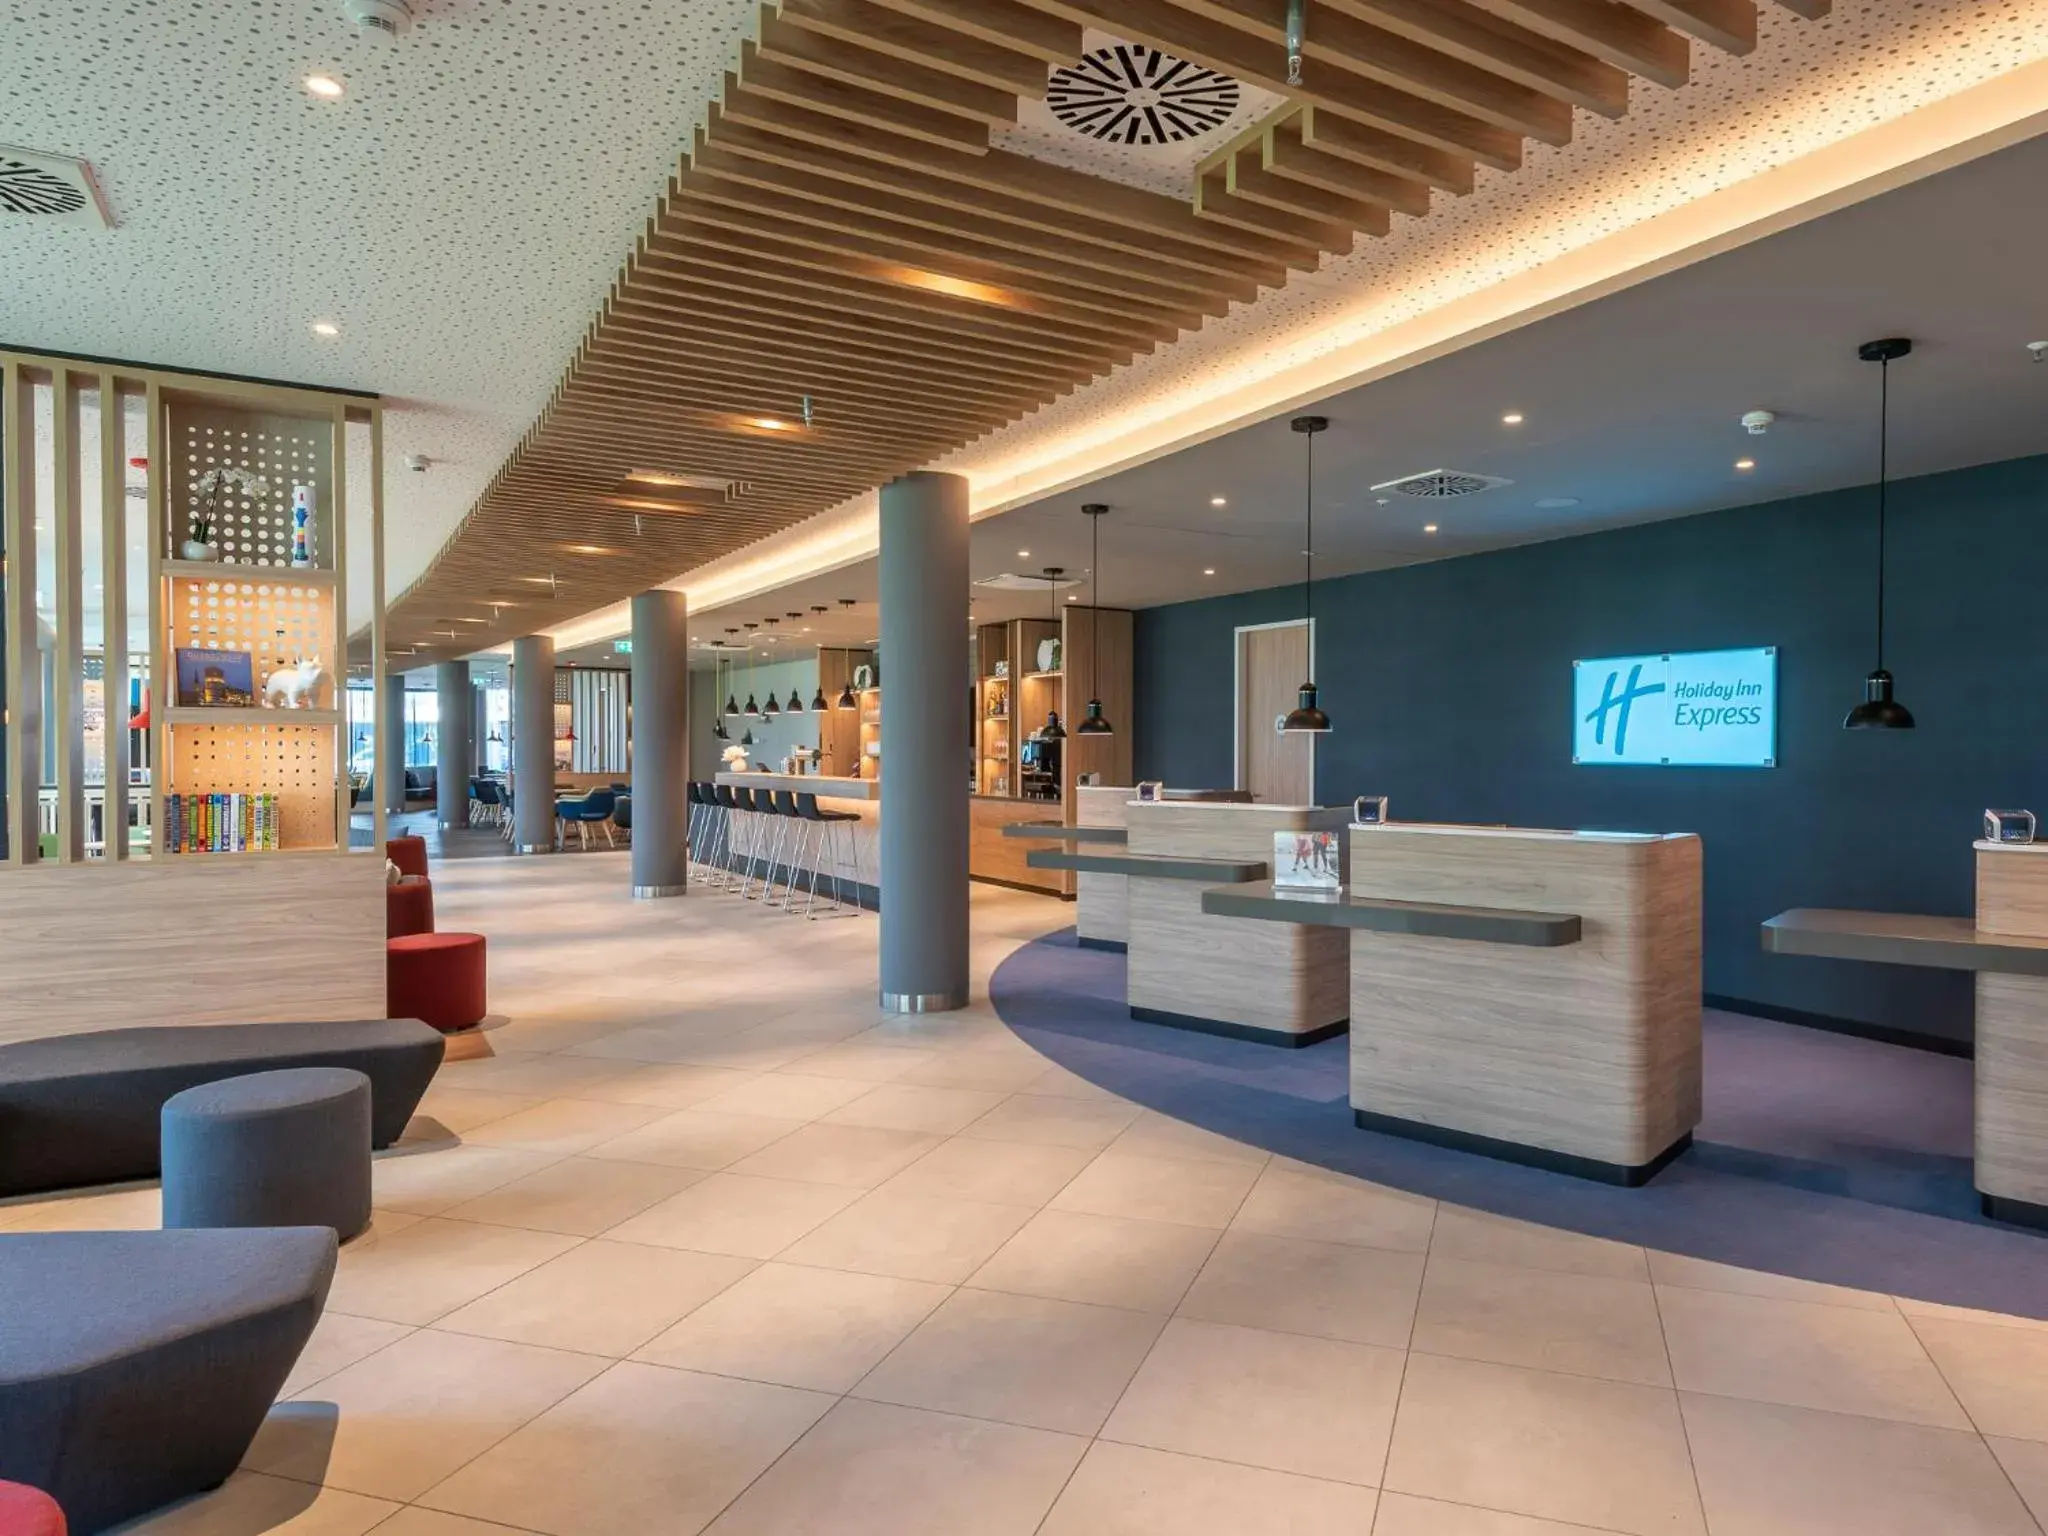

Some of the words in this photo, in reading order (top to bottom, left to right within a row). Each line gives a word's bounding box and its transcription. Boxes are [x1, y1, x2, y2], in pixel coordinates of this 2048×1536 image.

[1674, 680, 1734, 701] Holiday
[1736, 678, 1763, 697] Inn
[1674, 702, 1763, 732] Express
